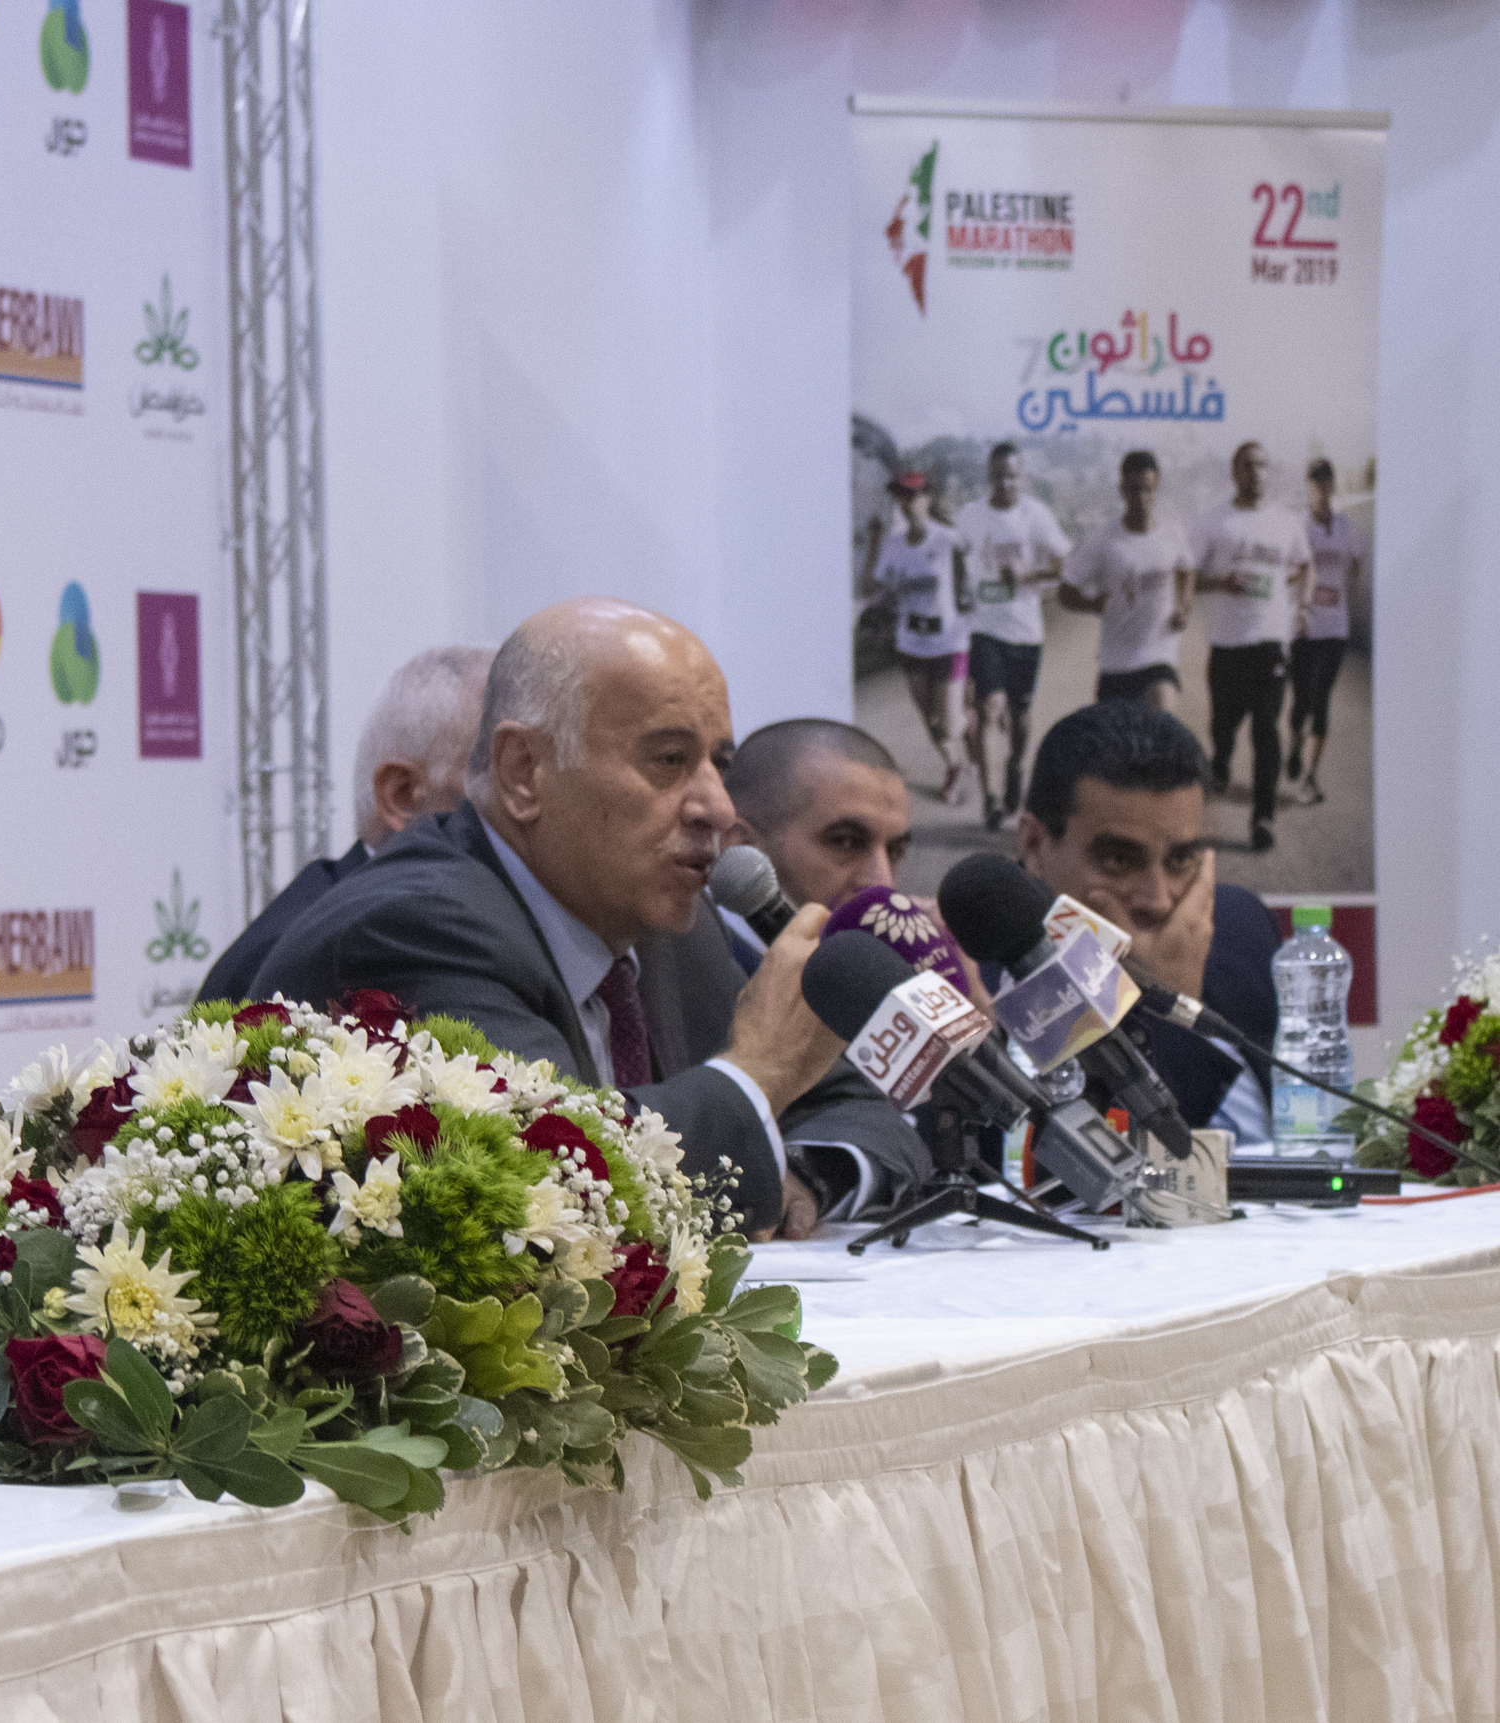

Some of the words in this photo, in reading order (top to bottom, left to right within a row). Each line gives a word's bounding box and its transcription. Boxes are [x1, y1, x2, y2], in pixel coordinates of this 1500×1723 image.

[946, 190, 1072, 225] PALESTINE
[946, 224, 1074, 256] MARATHON
[1251, 256, 1287, 284] Mar
[1294, 256, 1338, 286] 2019
[1048, 308, 1213, 376] ماراثون
[1017, 368, 1226, 433] فلسطين
[908, 985, 965, 1021] وطن
[857, 1010, 920, 1081] وطن
